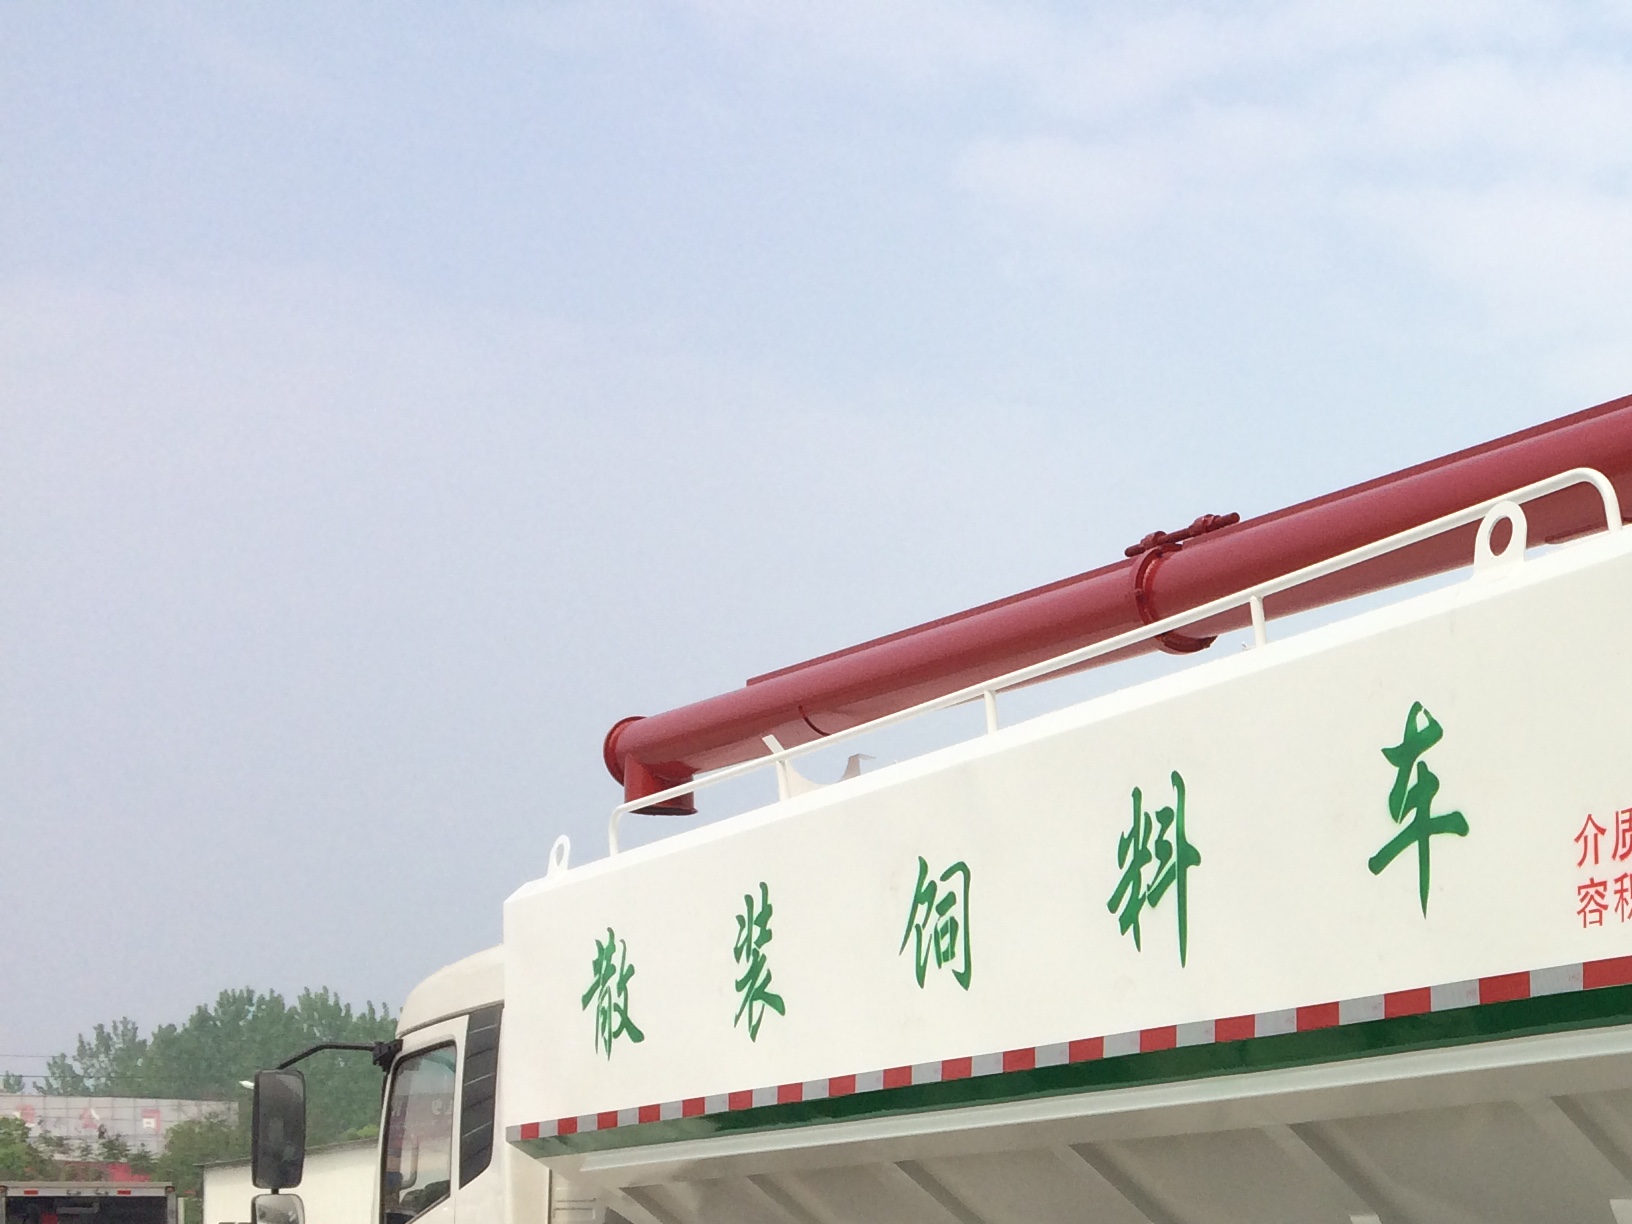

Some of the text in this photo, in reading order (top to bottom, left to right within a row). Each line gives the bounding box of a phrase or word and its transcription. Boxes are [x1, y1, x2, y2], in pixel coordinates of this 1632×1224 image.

[582, 701, 1470, 1062] 散装饲料车
